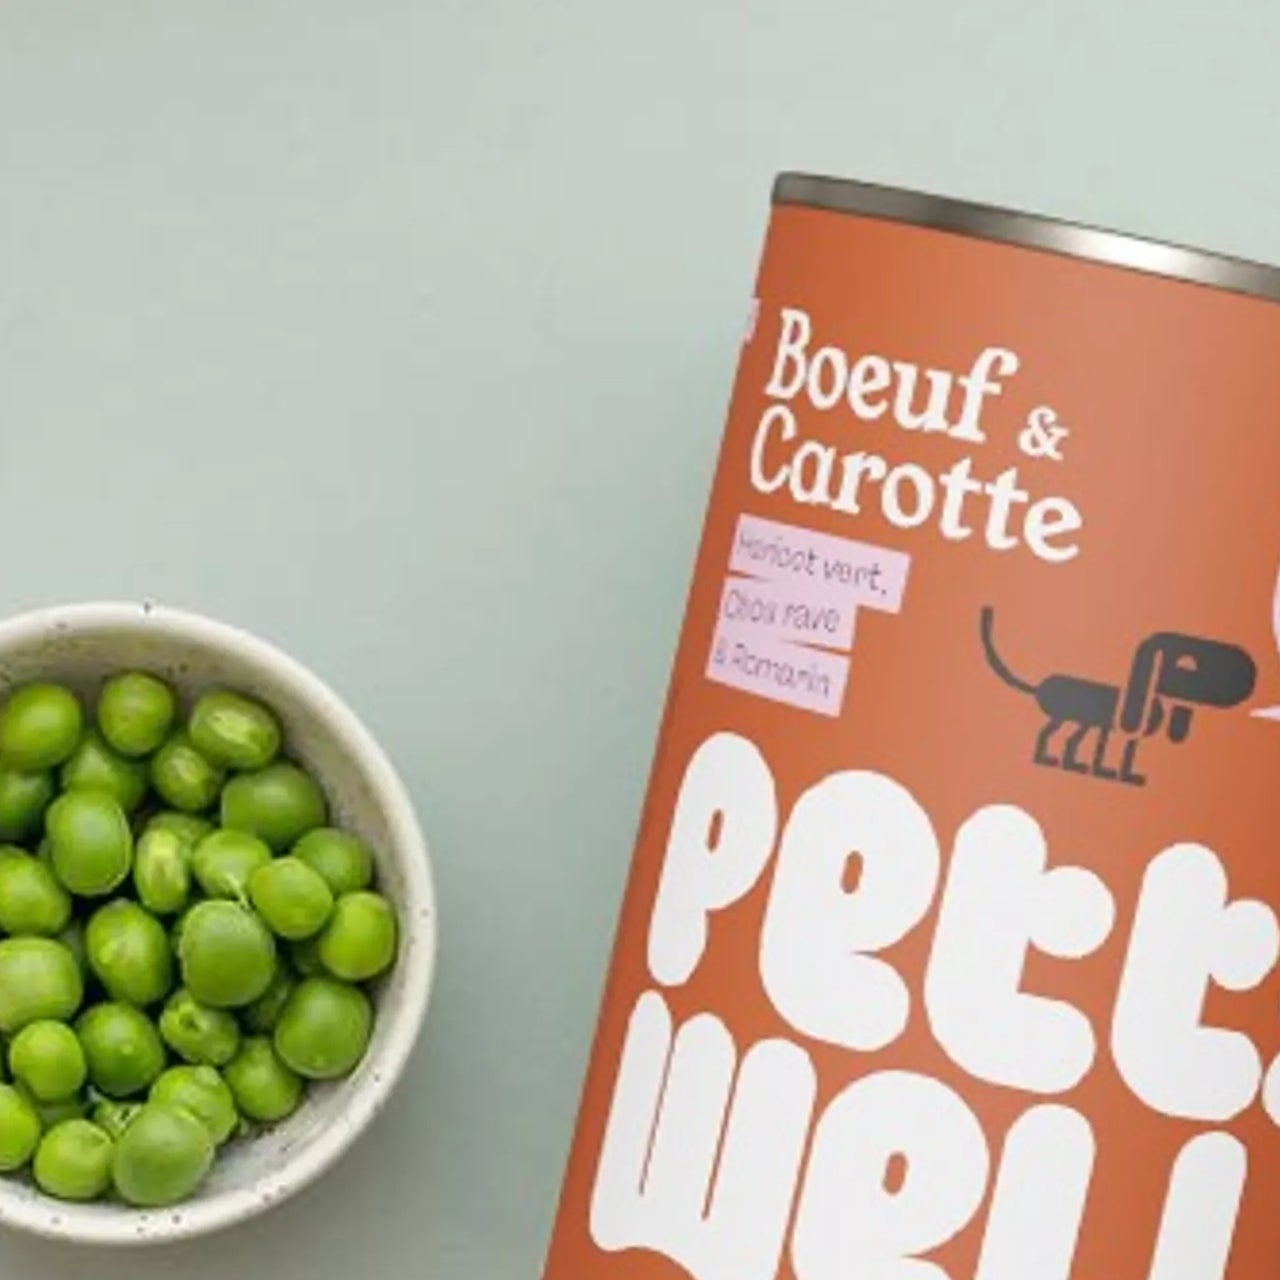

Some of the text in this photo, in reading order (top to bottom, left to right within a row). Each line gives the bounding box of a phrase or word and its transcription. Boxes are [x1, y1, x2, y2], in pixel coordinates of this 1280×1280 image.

[765, 307, 1068, 460] Boeuf &
[750, 404, 1083, 561] Carotte
